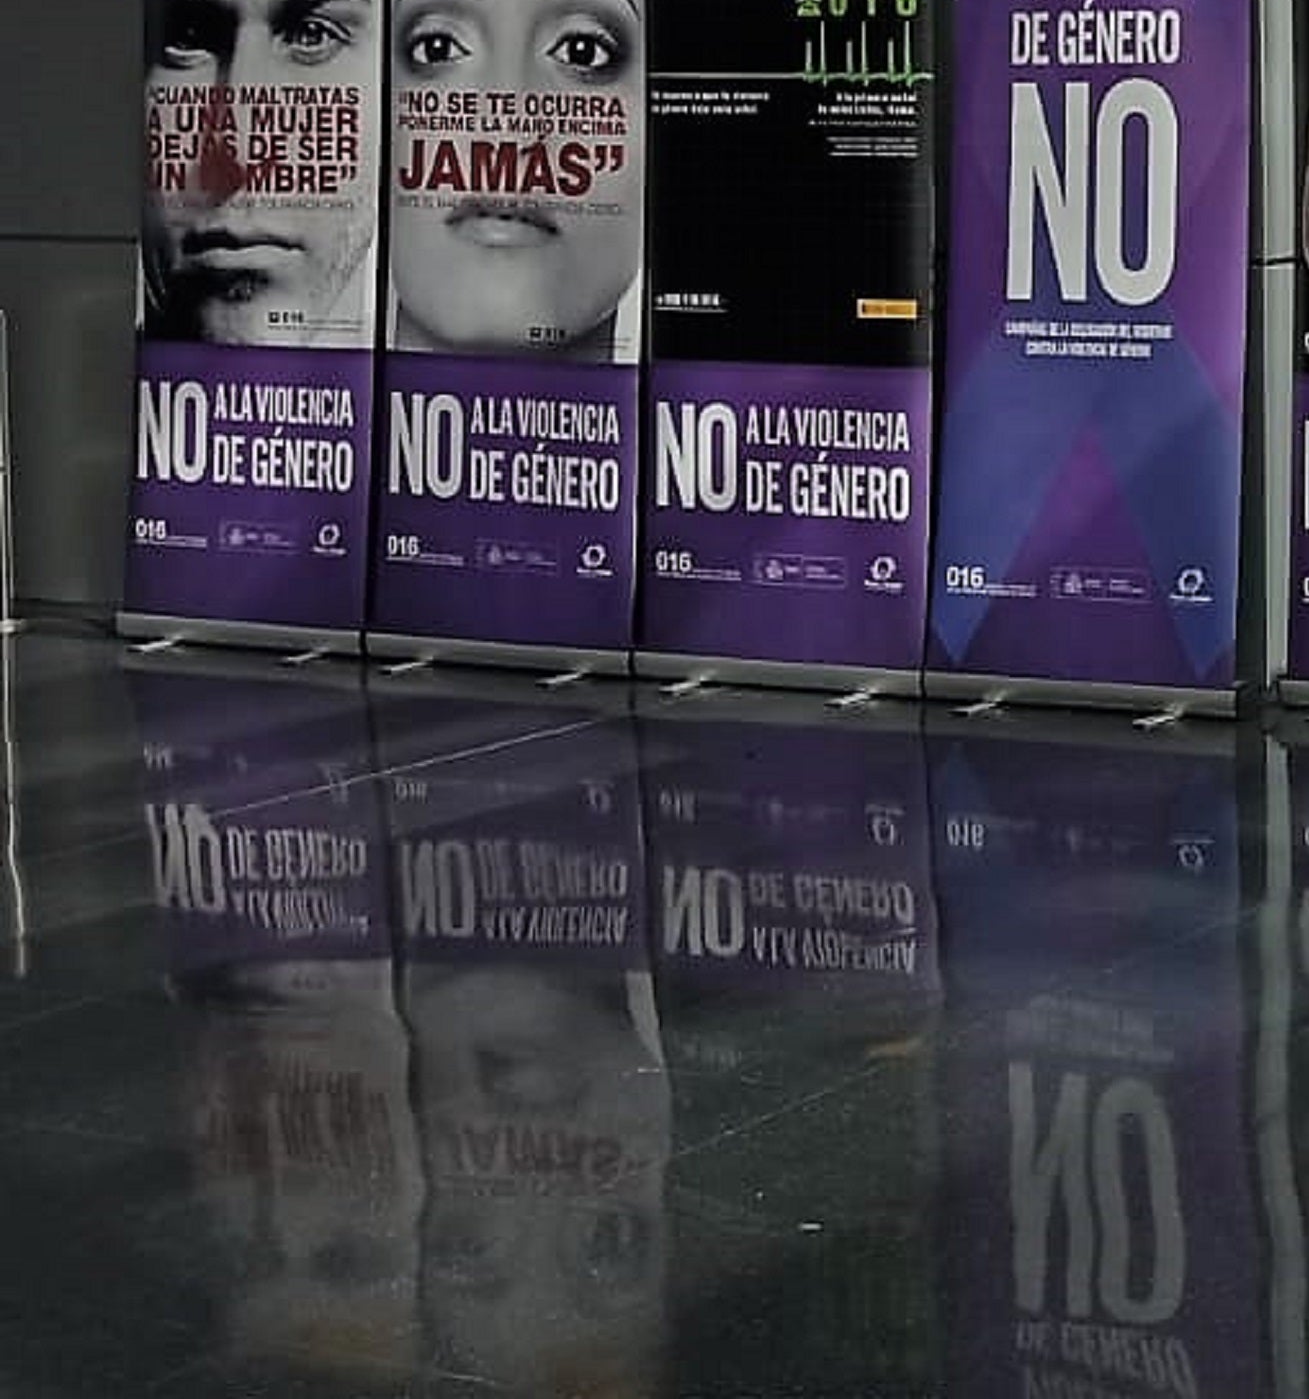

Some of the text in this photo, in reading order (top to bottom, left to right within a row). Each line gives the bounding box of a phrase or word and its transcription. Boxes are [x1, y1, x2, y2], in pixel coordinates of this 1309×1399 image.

[1012, 11, 1049, 66] DE
[176, 106, 359, 134] UNA MUJER
[240, 87, 359, 106] MALTRATAS
[447, 92, 478, 115] SE
[486, 94, 516, 116] TE
[525, 95, 626, 118] OCURRA
[149, 134, 359, 163] DEJAS DE SER
[482, 117, 501, 133] LA
[508, 118, 554, 135] MANO
[559, 120, 627, 137] ENCIMA
[1006, 78, 1179, 306] NO
[213, 384, 354, 428] A LA VIOLENCIA
[471, 397, 620, 445] A LA VIOLENCIA
[746, 406, 910, 453] A LA VIOLENCIA
[136, 380, 208, 483] NO
[389, 391, 465, 499] NO
[213, 427, 354, 493] DE GÉNERO
[470, 444, 620, 511] DE GÉNERO
[656, 400, 738, 512] NO
[746, 450, 911, 522] DE GÉNERO
[387, 535, 421, 556] 016
[655, 550, 692, 572] 016
[947, 566, 985, 587] 016
